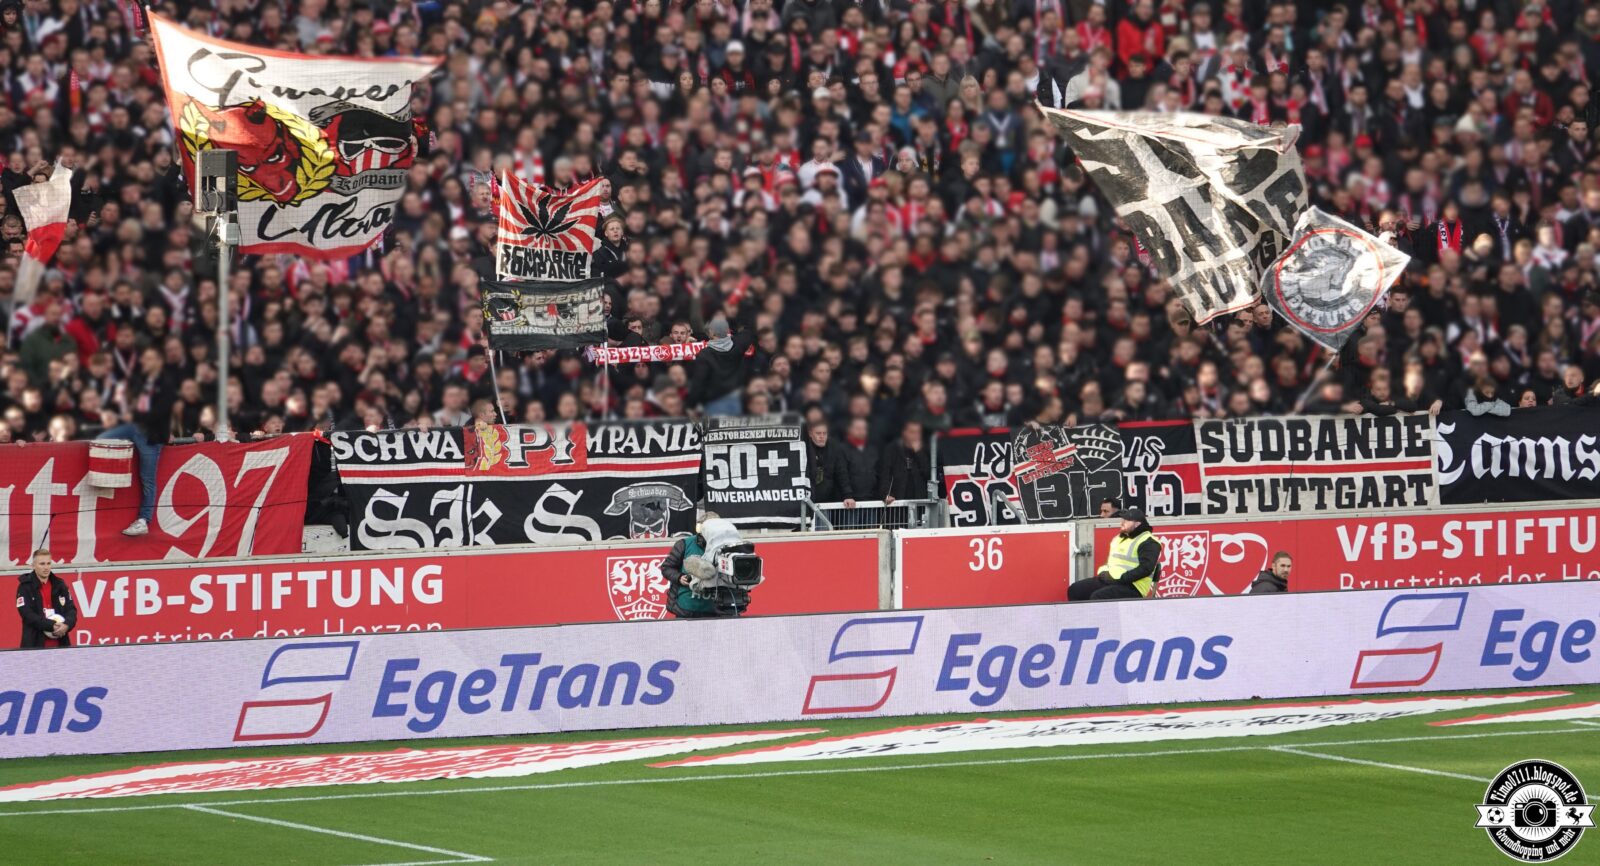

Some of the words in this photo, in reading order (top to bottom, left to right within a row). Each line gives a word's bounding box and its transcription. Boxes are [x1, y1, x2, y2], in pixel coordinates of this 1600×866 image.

[499, 252, 587, 279] KOMPANIE
[501, 244, 588, 264] SCHWABEN
[767, 428, 799, 440] ULTRAS
[1201, 414, 1432, 463] SÜDBANDE
[705, 441, 811, 489] 50+1
[156, 446, 290, 560] 97
[1206, 473, 1433, 515] STUTTGART
[969, 537, 1003, 571] 36
[1336, 515, 1597, 562] VfB-STIFTU
[72, 565, 443, 618] VfB-STIFTUNG
[935, 627, 1233, 707] EgeTrans
[1480, 609, 1600, 681] Ege
[372, 652, 681, 733] EgeTrans
